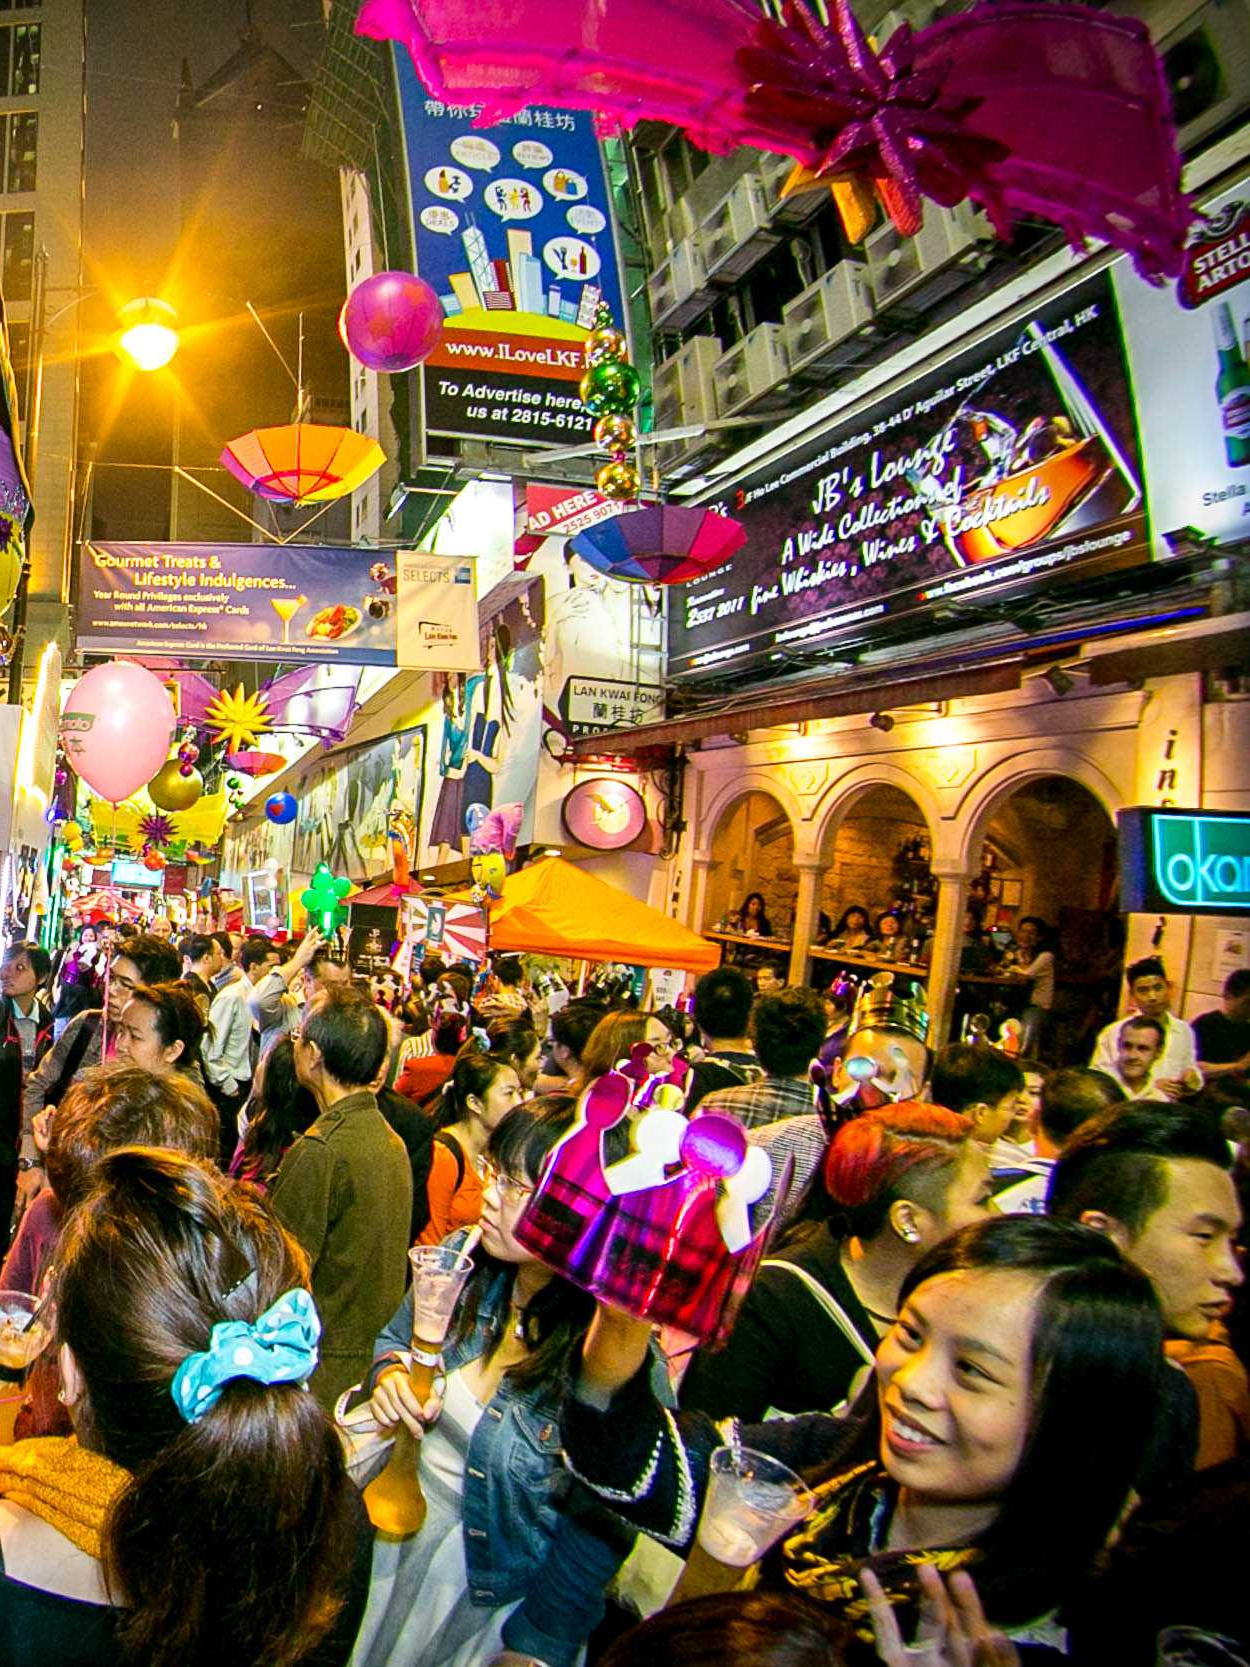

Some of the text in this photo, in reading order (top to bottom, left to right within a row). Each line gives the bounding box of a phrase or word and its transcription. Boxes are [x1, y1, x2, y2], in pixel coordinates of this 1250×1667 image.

[1075, 304, 1100, 326] HK
[439, 381, 458, 396] To
[462, 384, 541, 406] Advertise
[467, 406, 592, 431] us at 2815-6121
[810, 427, 959, 516] JB's Lounge
[528, 490, 598, 531] AD HERE
[781, 537, 795, 566] A
[797, 522, 837, 557] Wide
[95, 555, 221, 569] Gourmet Treats &
[134, 571, 196, 589] Lifestyle
[403, 568, 451, 584] SELECTS
[93, 590, 111, 600] Year
[113, 590, 141, 600] Round
[183, 593, 230, 604] exclusively
[114, 602, 133, 611] with
[134, 602, 146, 612] all
[147, 603, 187, 614] American
[225, 605, 250, 616] Cards
[573, 685, 597, 697] LAN
[600, 687, 630, 701] KWAI
[593, 702, 644, 723] 蘭桂坊
